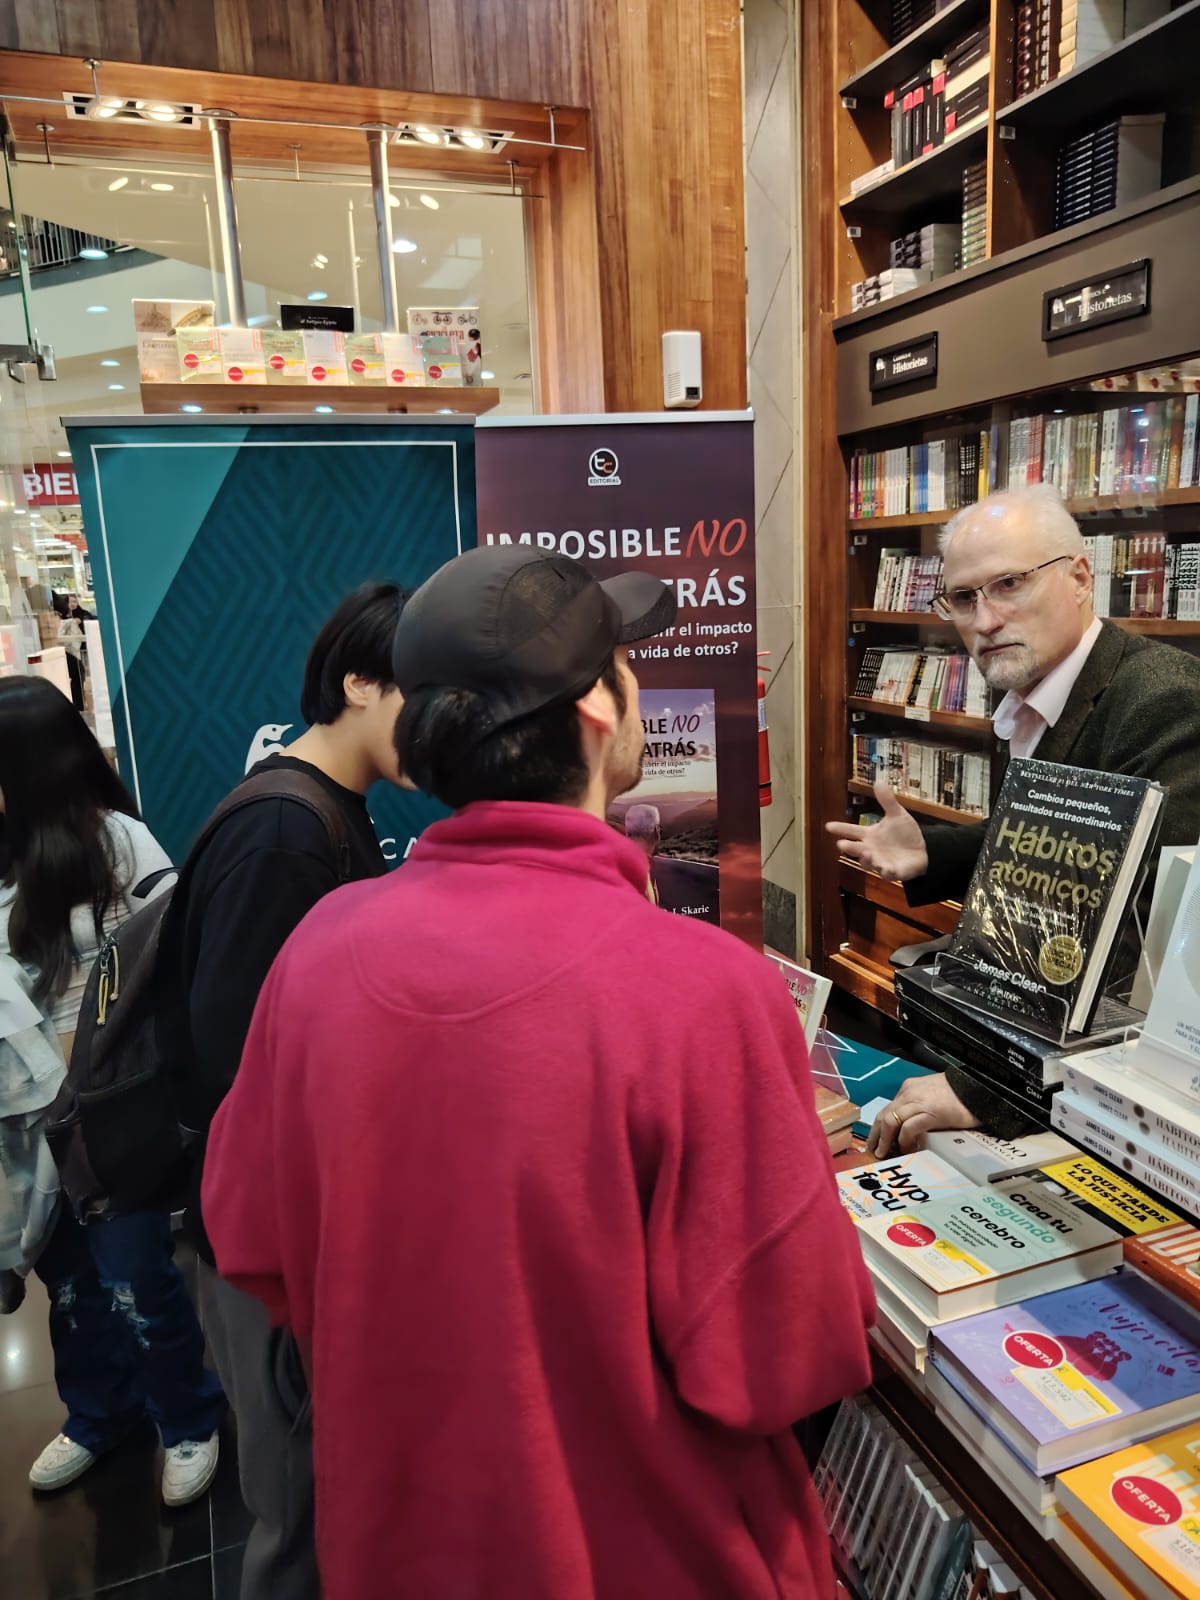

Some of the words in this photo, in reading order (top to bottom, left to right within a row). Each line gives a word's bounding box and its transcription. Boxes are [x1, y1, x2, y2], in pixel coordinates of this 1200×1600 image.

[893, 356, 928, 375] Historietas
[686, 518, 748, 558] NO
[679, 623, 692, 636] el
[696, 622, 753, 637] impacto
[640, 645, 669, 659] vida
[673, 644, 690, 657] de
[694, 641, 739, 656] otros?
[671, 714, 700, 733] NO
[1010, 801, 1053, 817] resultados
[1054, 811, 1122, 832] extraordinarios
[1028, 789, 1064, 805] Cambios
[1065, 797, 1111, 815] pequeños,
[995, 817, 1117, 875] Hábitos
[989, 860, 1103, 909] atómicos
[681, 904, 710, 916] Skaric
[974, 958, 1010, 982] James
[1011, 972, 1047, 994] Clear
[1026, 1086, 1043, 1100] Clear
[1093, 1084, 1108, 1099] JAMES
[1108, 1092, 1123, 1104] CLEAR
[1083, 1135, 1098, 1149] JAMES
[1098, 1143, 1112, 1157] CLEAR
[1085, 1120, 1101, 1134] JAMES
[1101, 1128, 1115, 1141] CLEAR
[1066, 1170, 1086, 1183] LA
[1085, 1182, 1149, 1223] JUSTICIA
[1072, 1163, 1093, 1175] LO
[1092, 1174, 1121, 1193] QUE
[1120, 1192, 1170, 1223] TARDE
[960, 1205, 1026, 1249] cerebro
[982, 1194, 1056, 1244] segundo
[1009, 1193, 1052, 1221] Crea
[1050, 1217, 1073, 1234] tu
[895, 1224, 927, 1246] OFERTA
[1013, 1335, 1054, 1366] OFERTA
[1122, 1479, 1171, 1523] OFERTA
